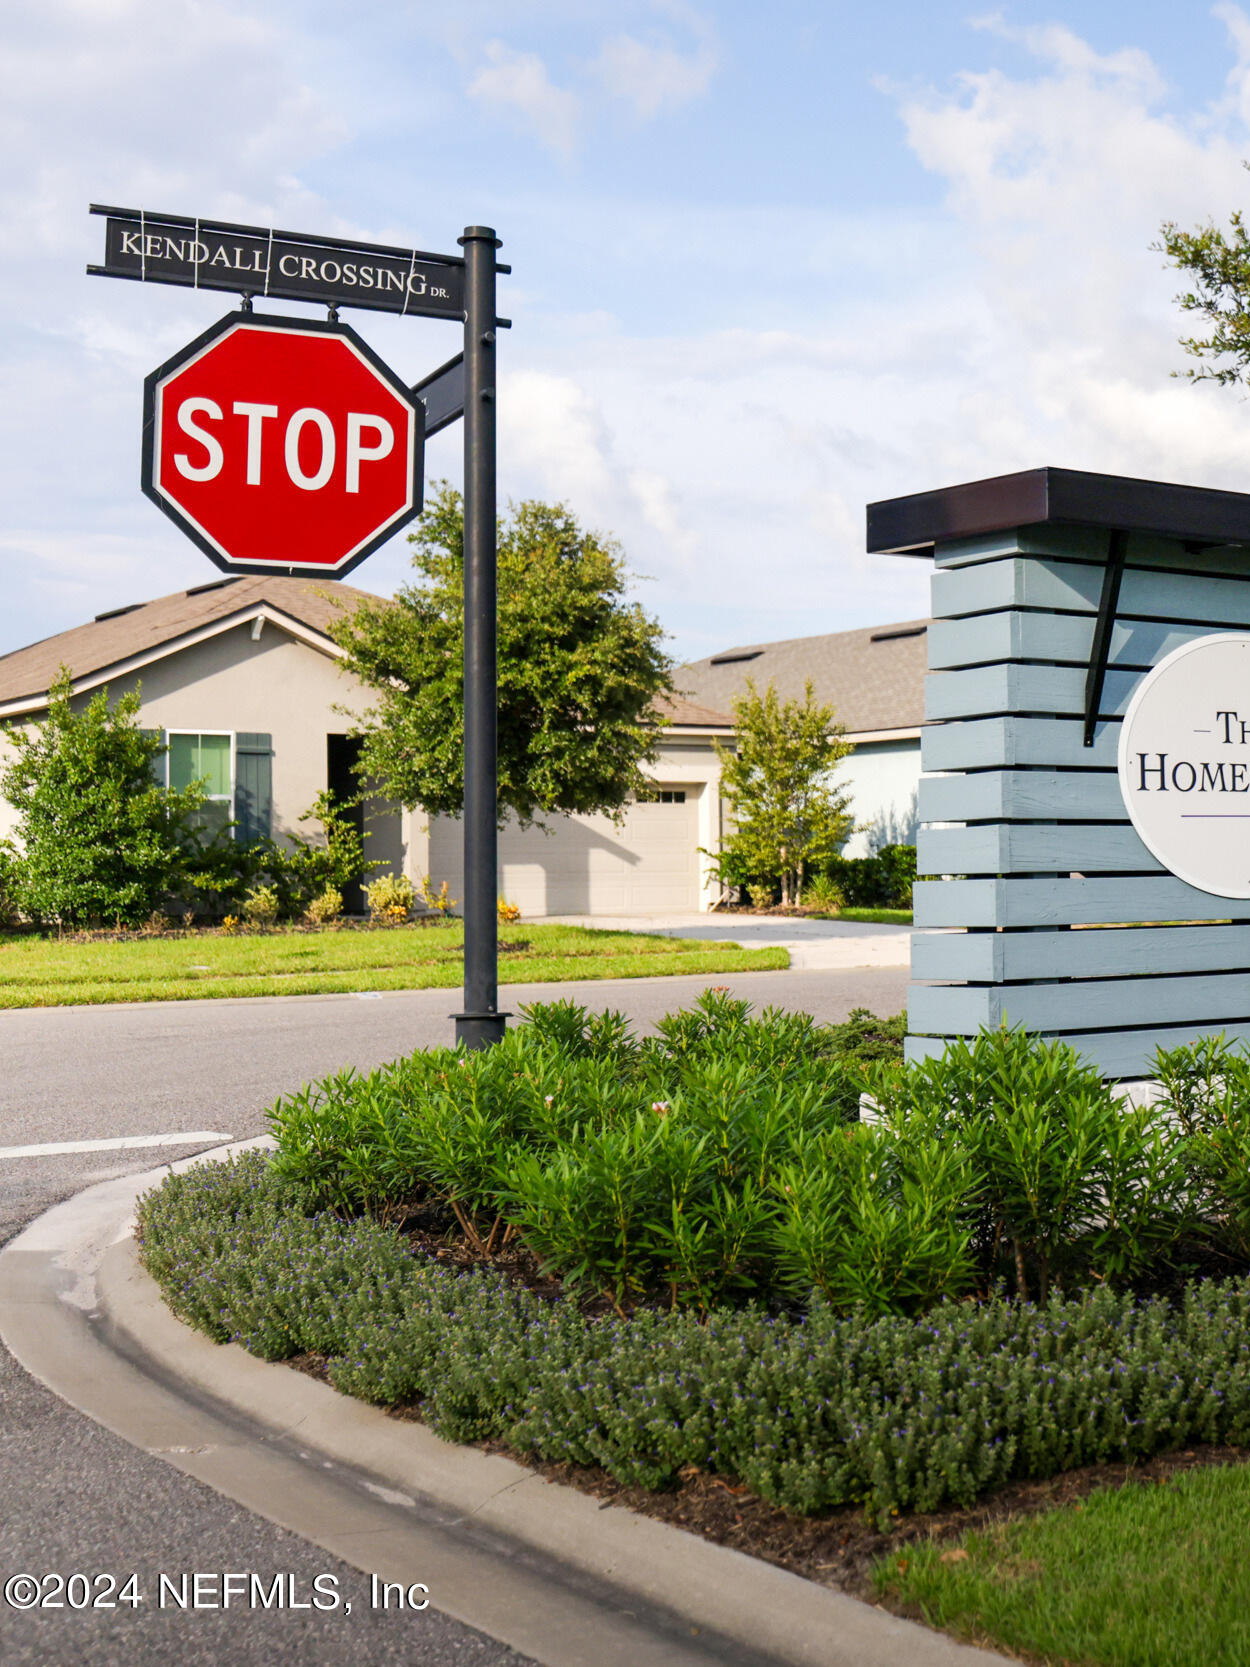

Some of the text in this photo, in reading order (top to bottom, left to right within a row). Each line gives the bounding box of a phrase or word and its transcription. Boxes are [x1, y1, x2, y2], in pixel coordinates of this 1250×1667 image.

[119, 231, 450, 299] KENDALL CROSSING DR.
[173, 396, 395, 494] STOP
